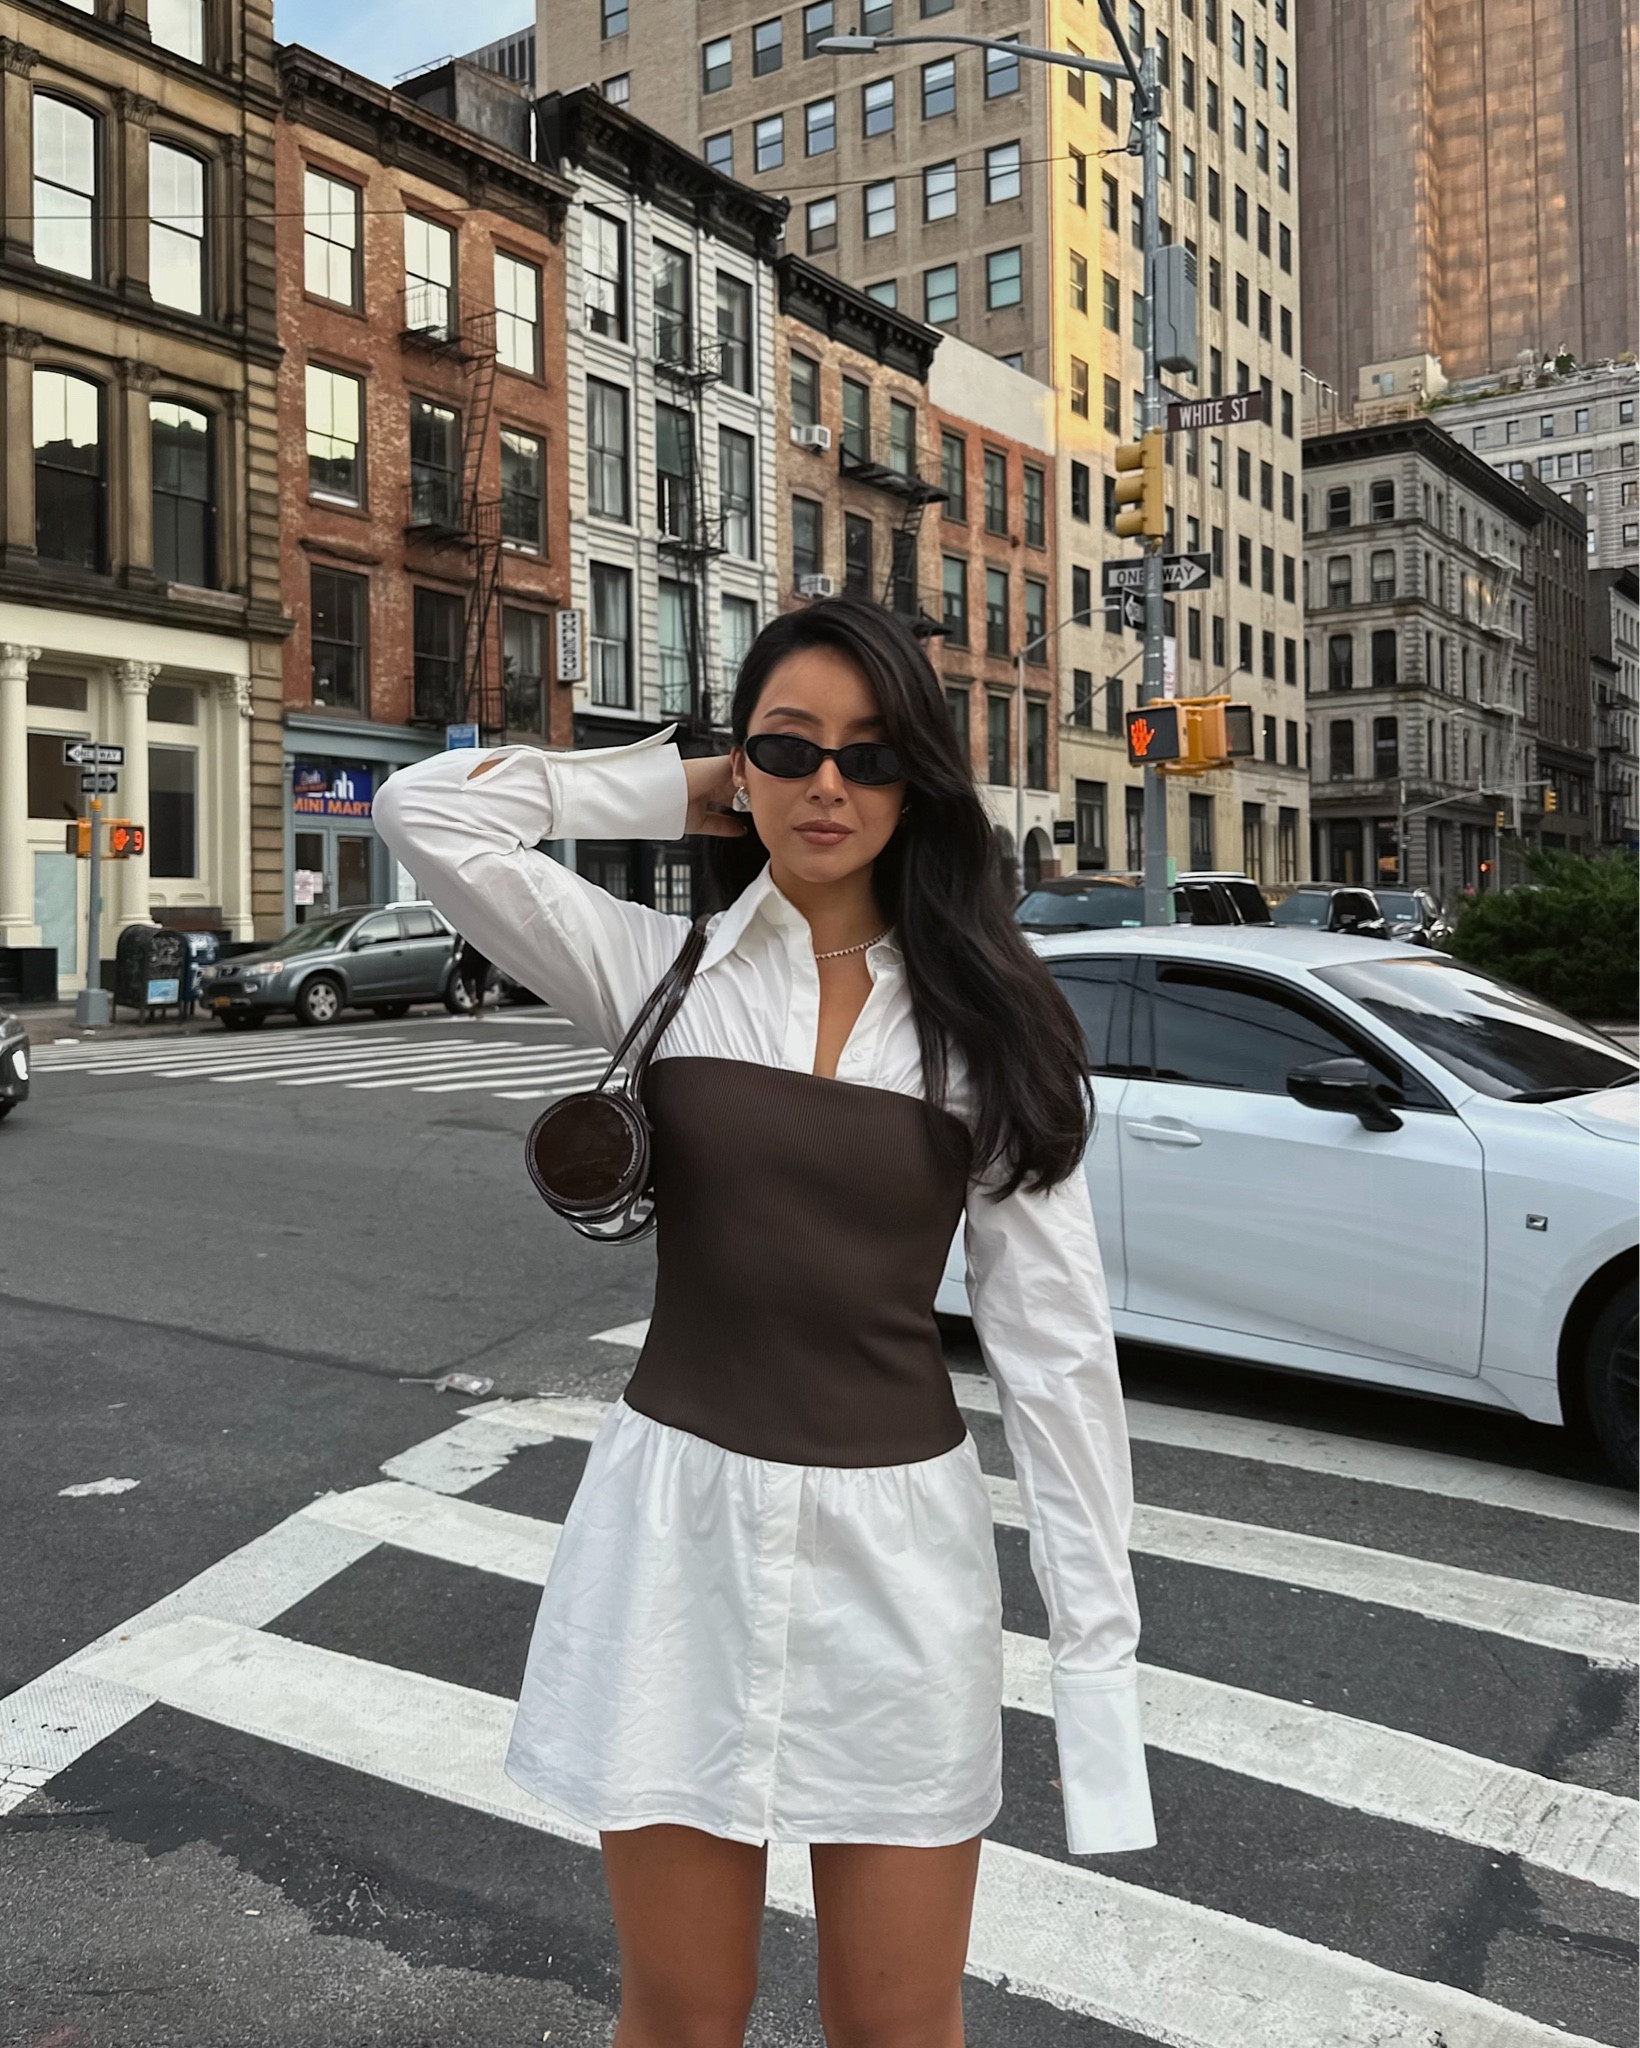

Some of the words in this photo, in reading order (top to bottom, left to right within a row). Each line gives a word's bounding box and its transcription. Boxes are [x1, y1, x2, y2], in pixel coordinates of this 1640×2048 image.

[1179, 401, 1224, 429] WHITE
[1231, 397, 1248, 421] ST
[1162, 566, 1194, 581] WAY
[293, 798, 325, 813] MINI
[327, 800, 371, 816] MART
[133, 828, 143, 852] 9
